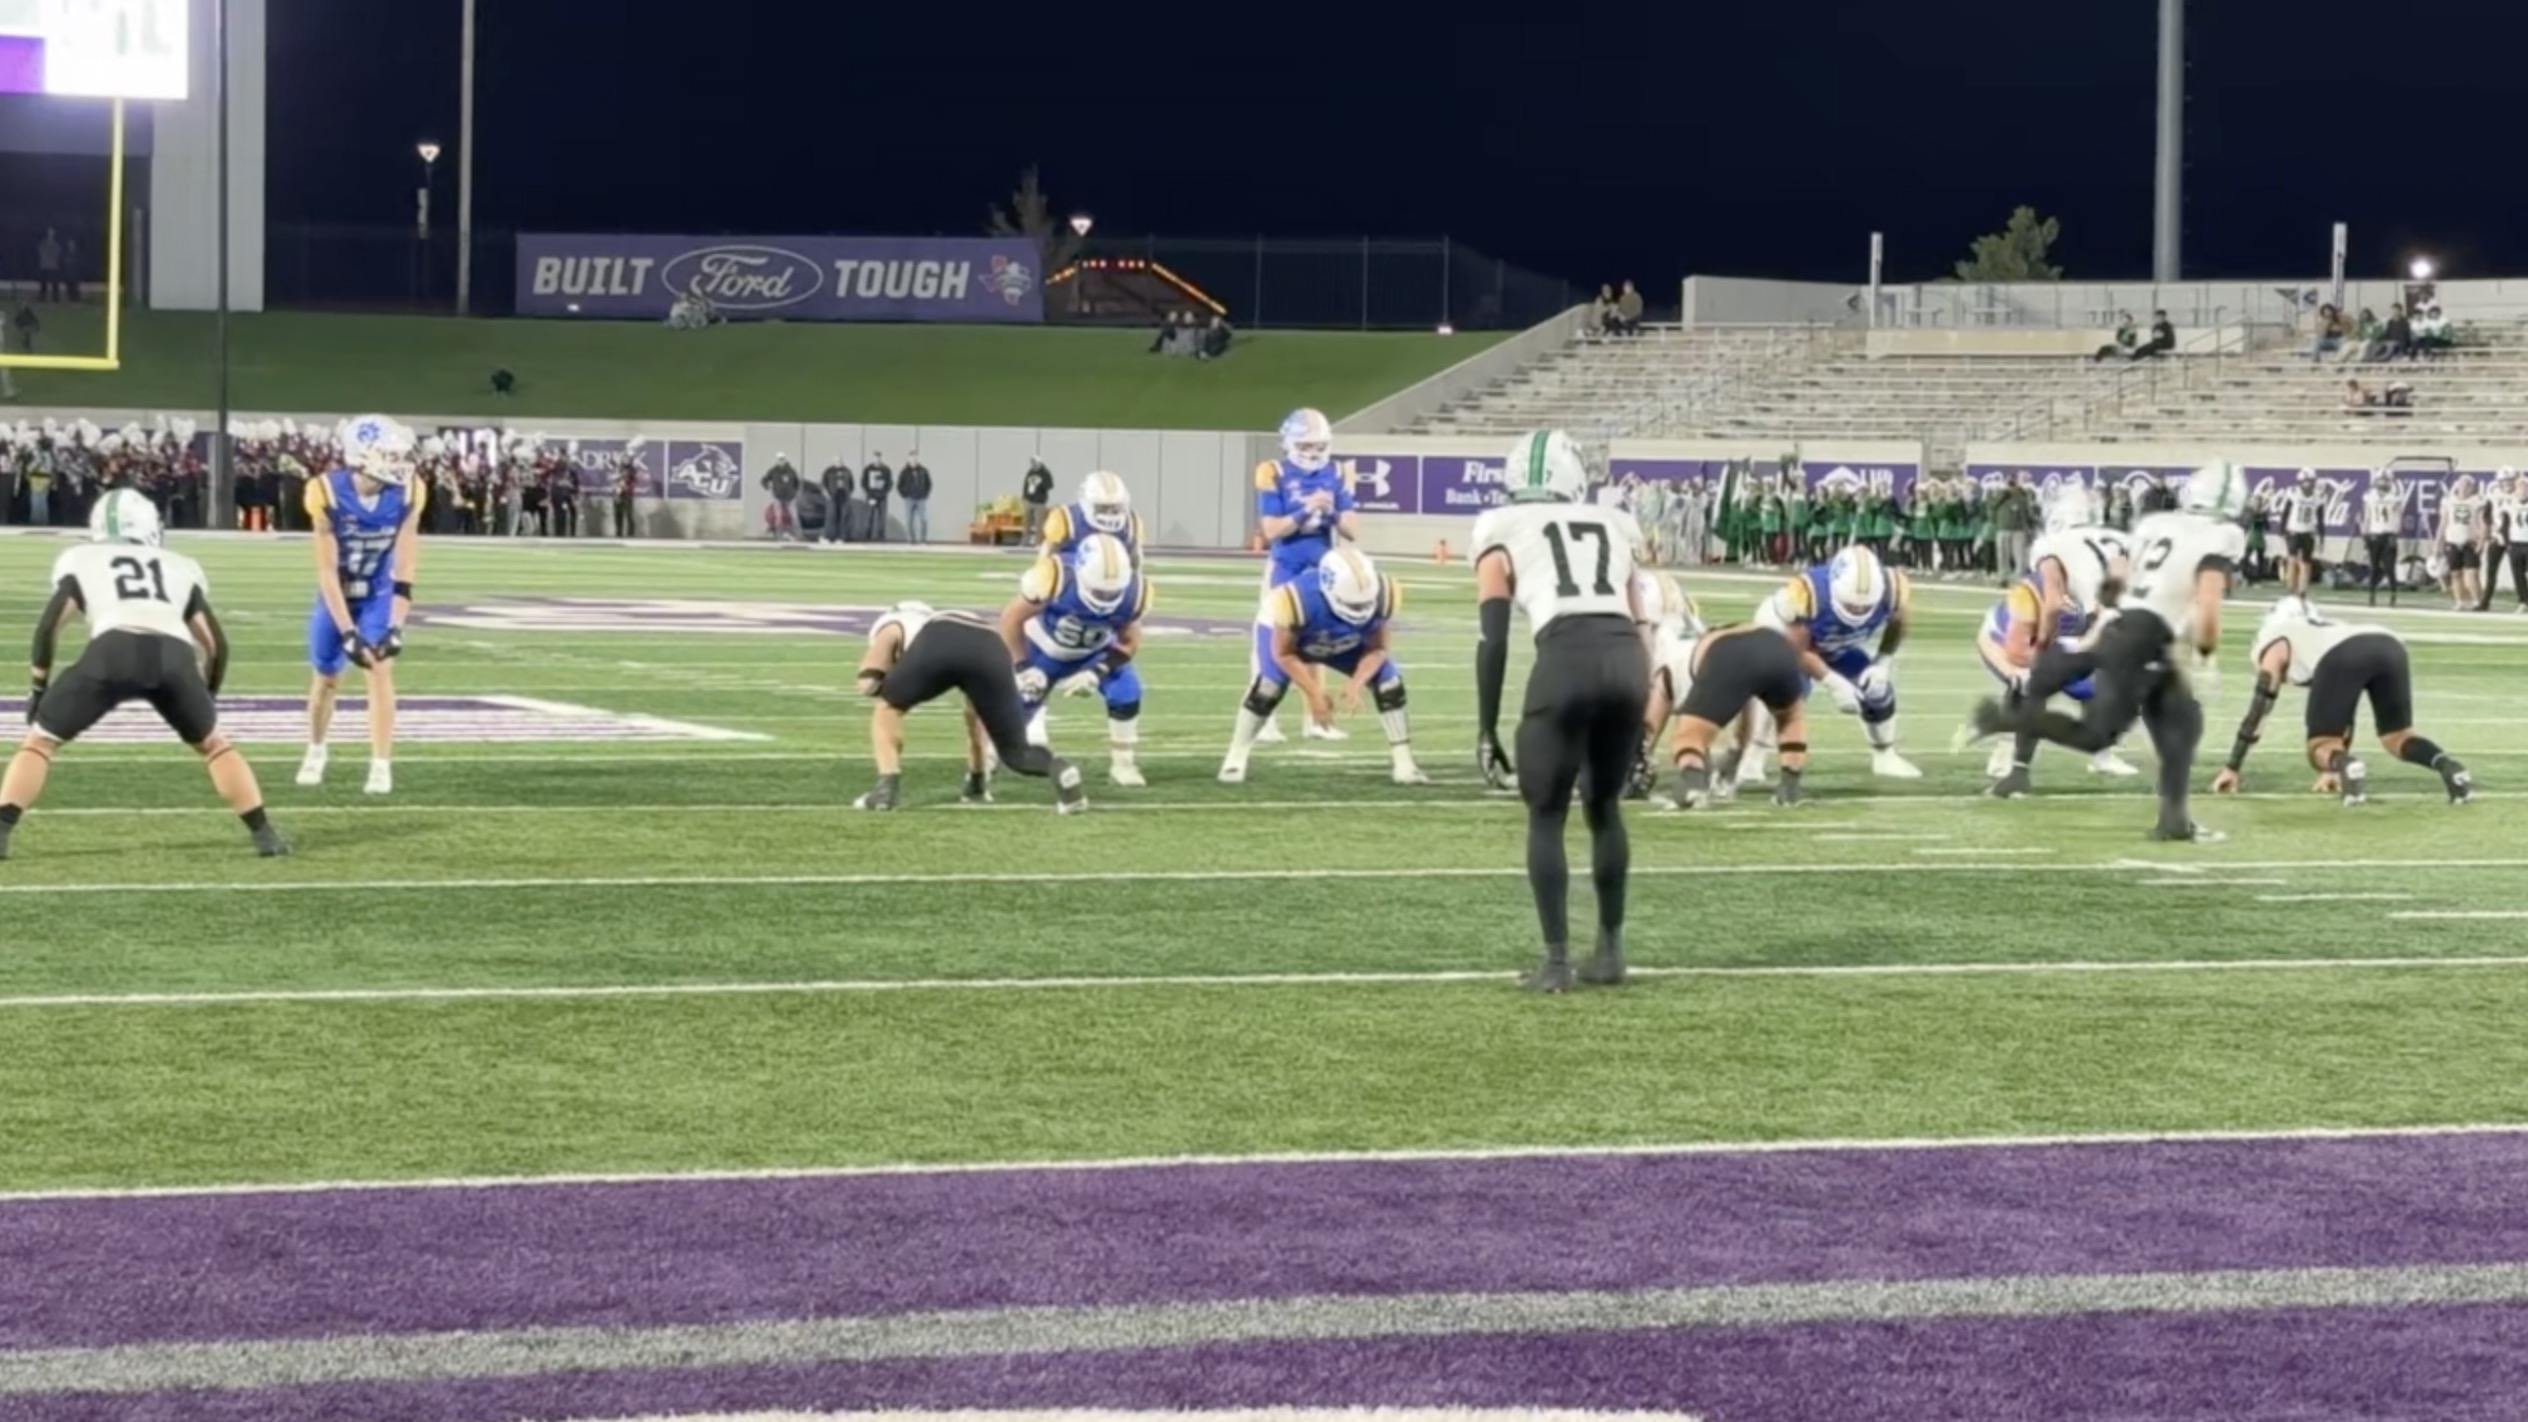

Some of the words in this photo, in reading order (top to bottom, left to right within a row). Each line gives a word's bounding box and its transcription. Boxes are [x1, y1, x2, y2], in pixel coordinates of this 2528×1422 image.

[533, 258, 654, 294] BUILT
[692, 253, 793, 302] Ford
[834, 260, 970, 299] TOUGH
[679, 463, 729, 493] ACU
[1445, 488, 1482, 505] Bank
[109, 556, 171, 604] 21
[1542, 521, 1616, 598] 17
